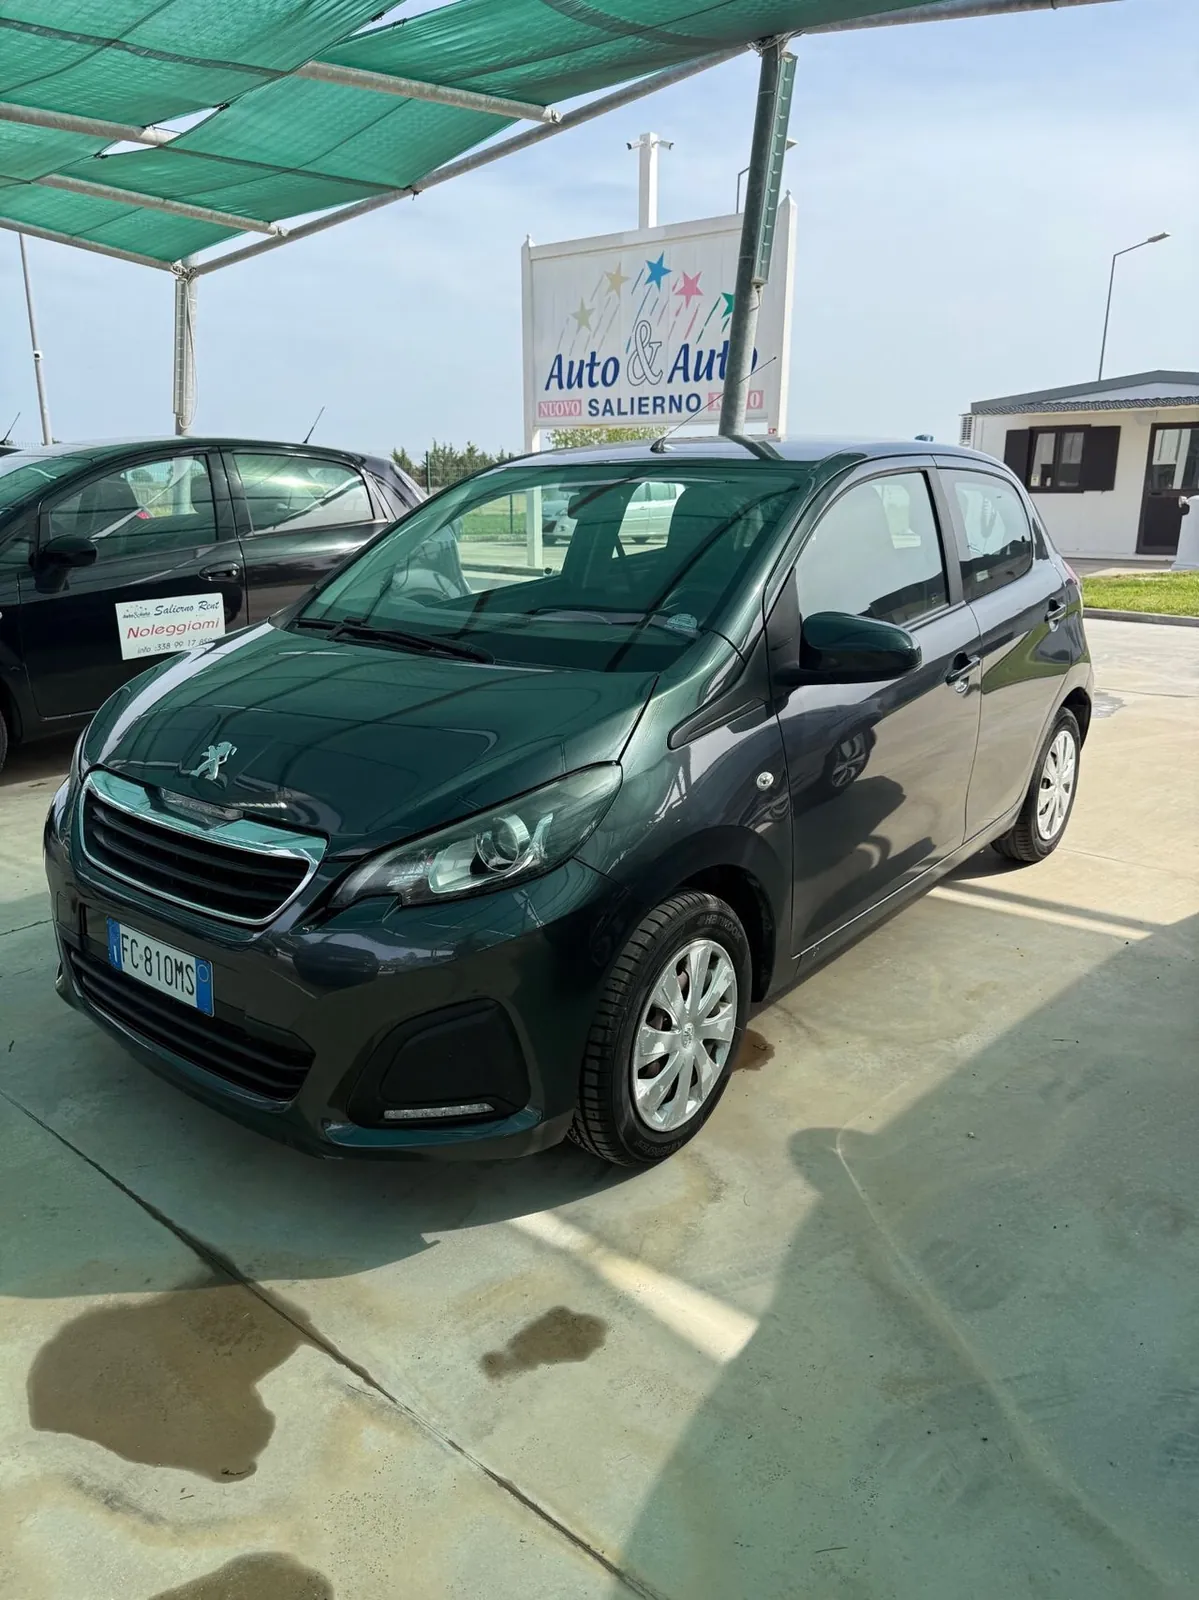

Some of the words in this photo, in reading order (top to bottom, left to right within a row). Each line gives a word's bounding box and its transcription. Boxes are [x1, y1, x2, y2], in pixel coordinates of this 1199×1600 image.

[545, 352, 620, 391] Auto
[626, 320, 664, 387] &
[667, 340, 757, 384] Aut
[539, 401, 580, 417] NUOVO
[588, 393, 702, 417] SALIERNO
[198, 600, 220, 611] Rent
[127, 618, 220, 639] Noleggiami
